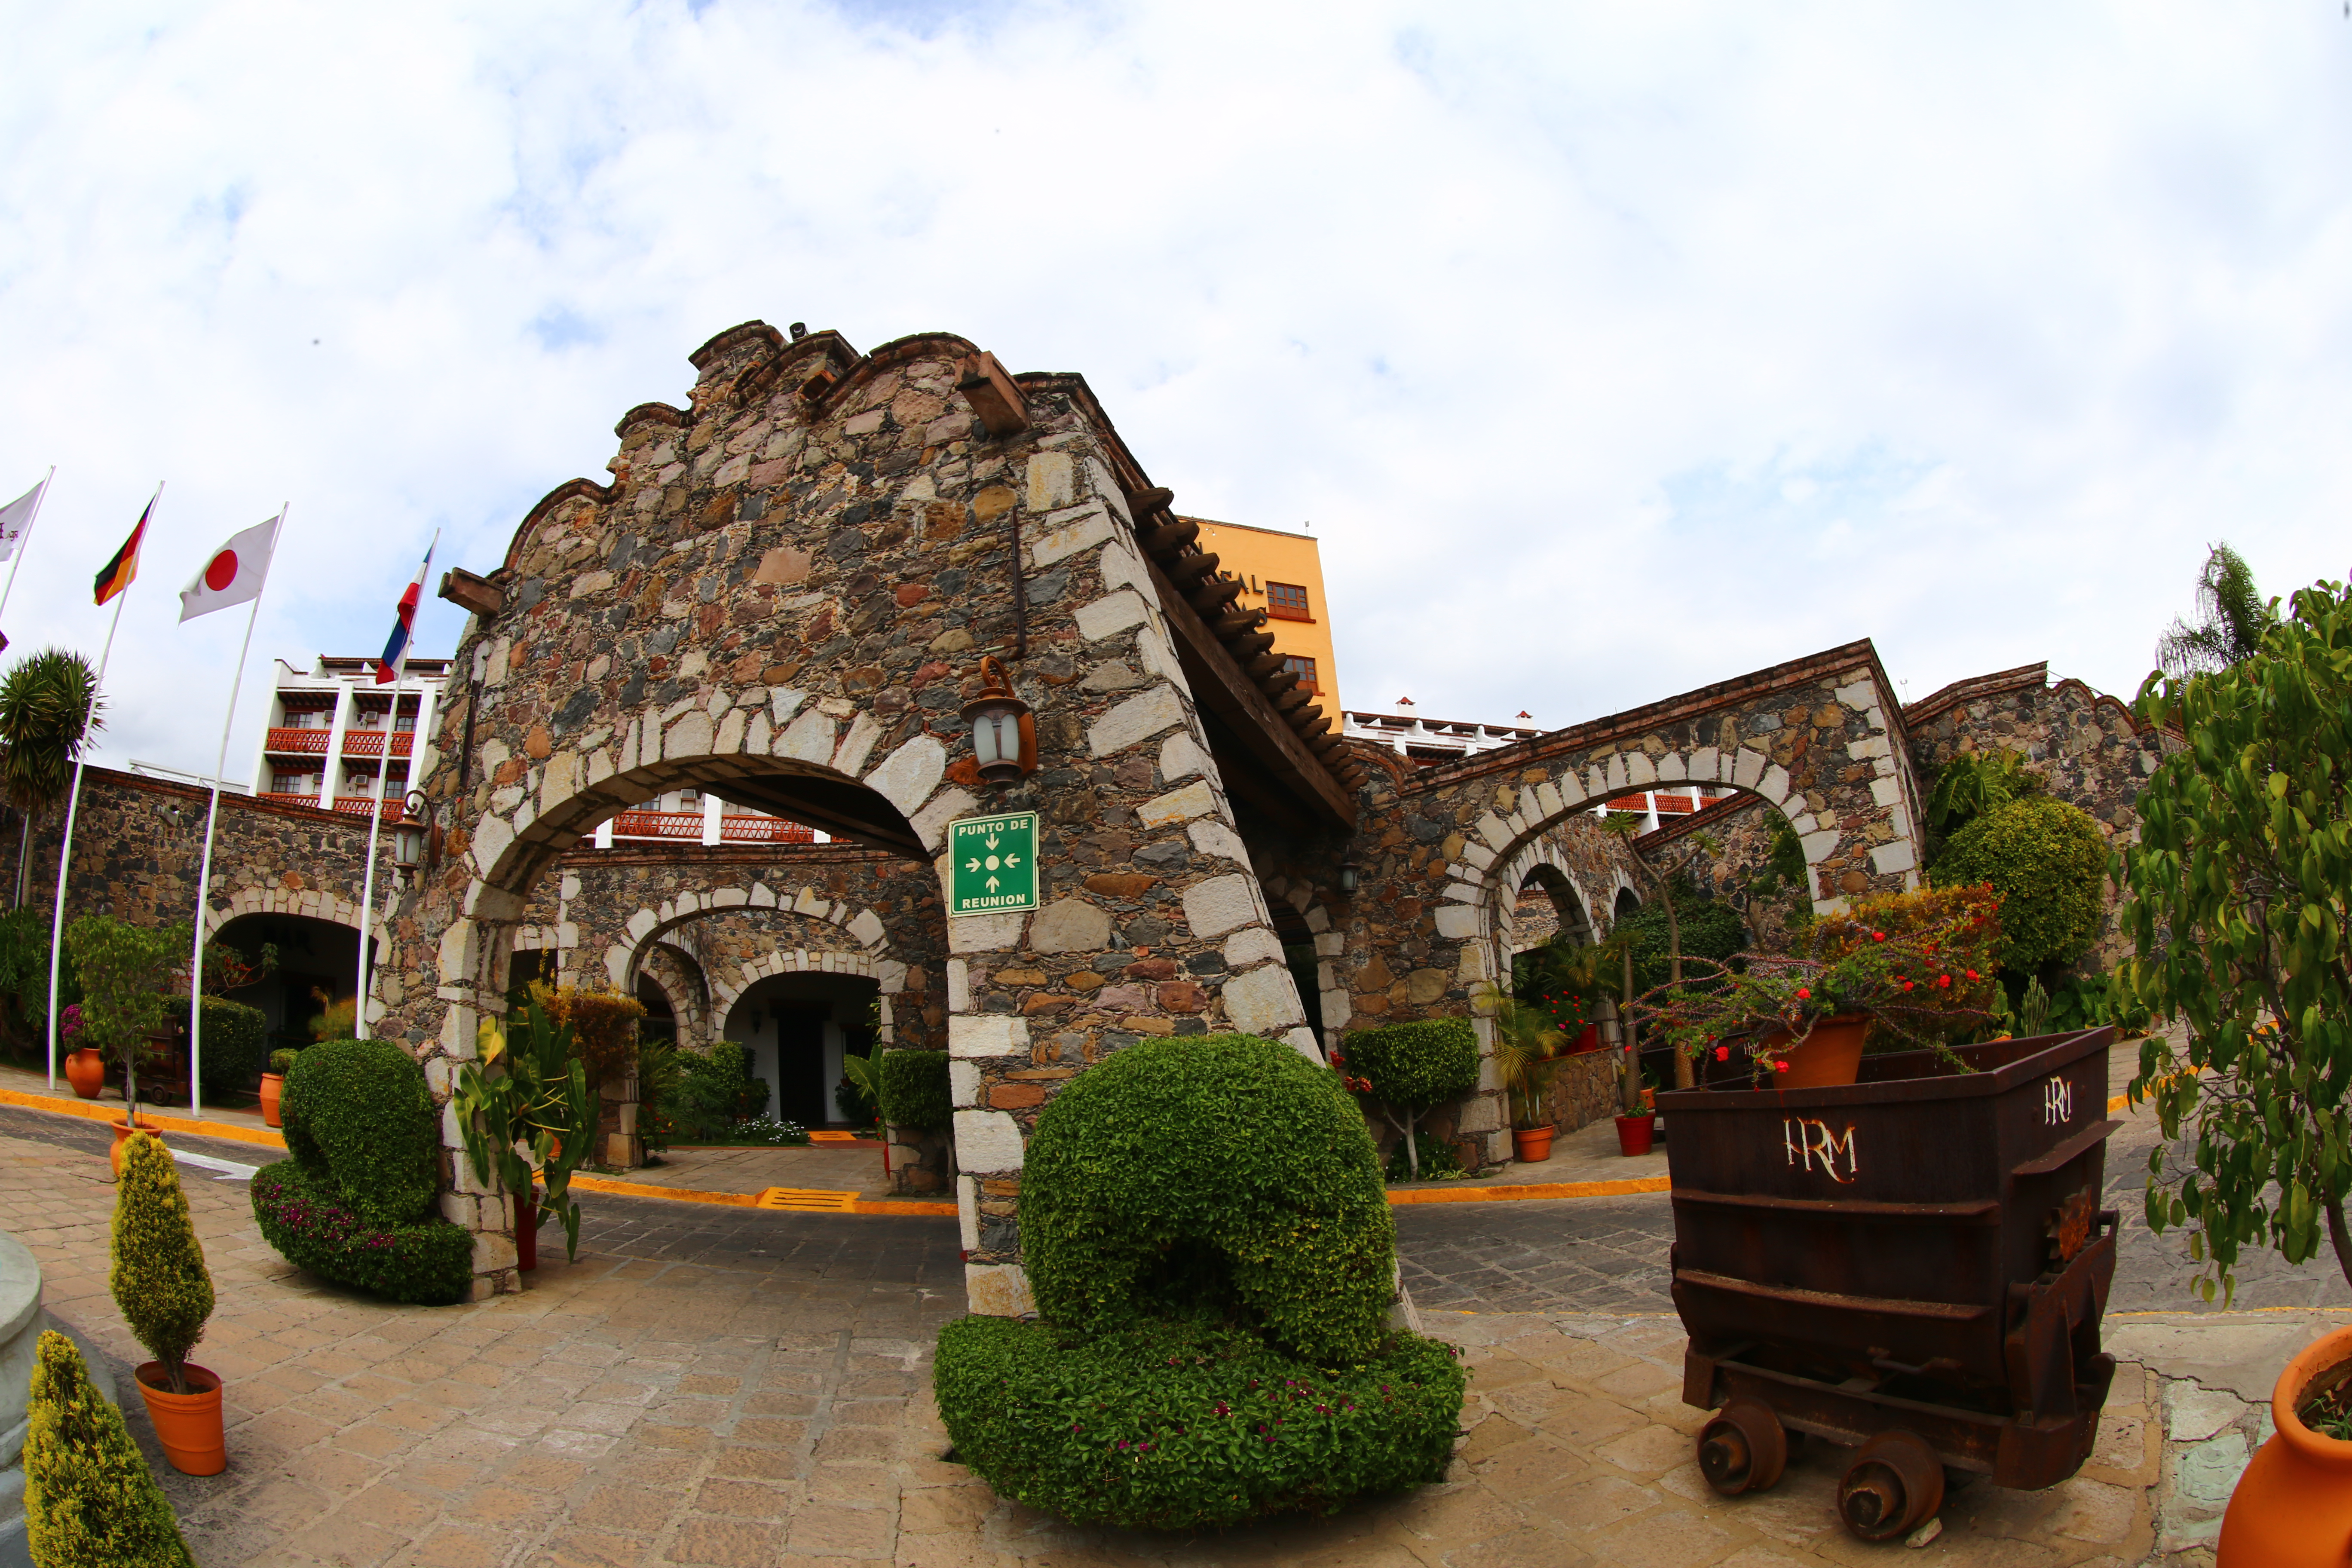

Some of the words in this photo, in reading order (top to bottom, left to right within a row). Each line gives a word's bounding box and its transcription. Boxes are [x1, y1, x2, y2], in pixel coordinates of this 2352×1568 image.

[1220, 570, 1265, 594] EAL
[959, 822, 1004, 836] PUNTO
[1010, 819, 1029, 830] DE
[962, 894, 1026, 909] REUNION
[263, 925, 315, 956] BAR
[2045, 1076, 2071, 1125] HRM
[1783, 1117, 1858, 1184] HRM
